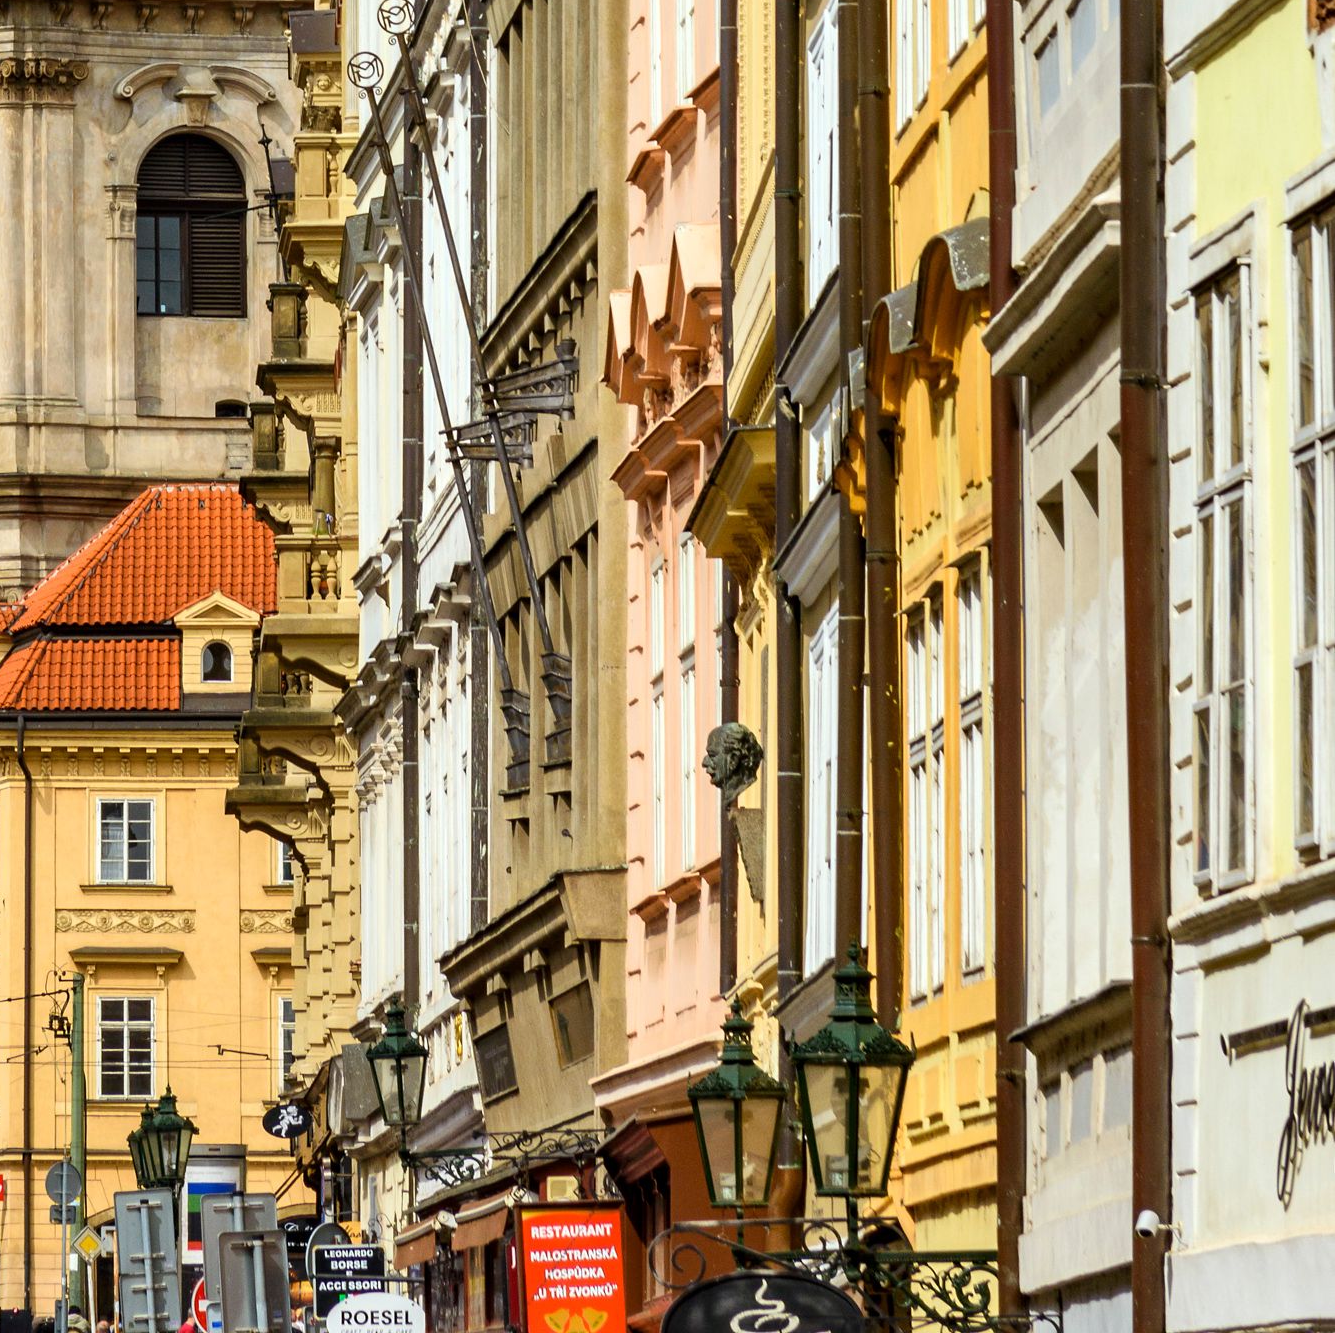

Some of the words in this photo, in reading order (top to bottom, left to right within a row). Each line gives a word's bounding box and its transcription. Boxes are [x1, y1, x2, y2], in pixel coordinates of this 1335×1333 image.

[530, 1223, 613, 1239] RESTAURANT
[324, 1249, 374, 1258] LEONARDO
[530, 1246, 618, 1262] MALOSTRANSKÁ
[330, 1260, 368, 1270] BORSE
[544, 1265, 605, 1280] HOSPŮDKA
[549, 1285, 567, 1299] TŘÍ
[340, 1310, 413, 1325] ROESEL
